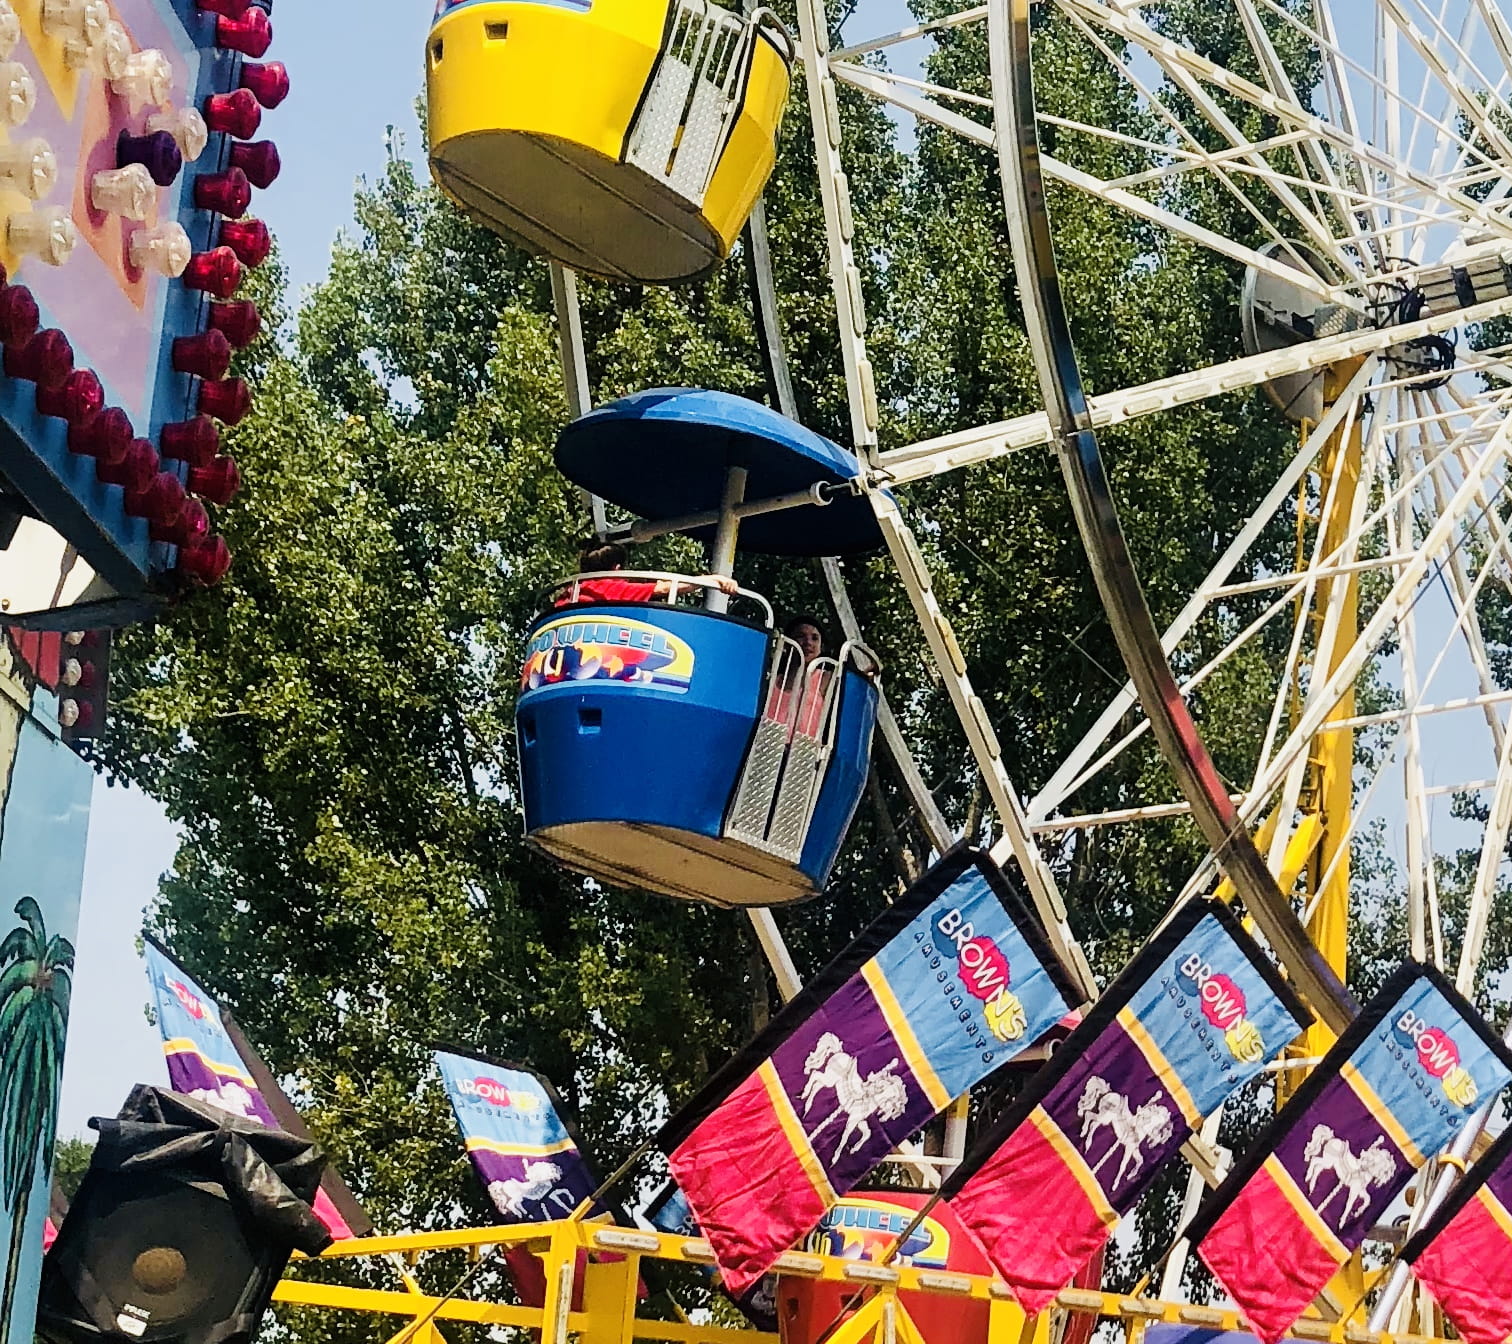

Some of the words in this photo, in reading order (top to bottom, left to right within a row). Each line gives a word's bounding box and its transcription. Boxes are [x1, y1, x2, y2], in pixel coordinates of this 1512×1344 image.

[557, 622, 674, 659] WHEEL
[914, 931, 994, 1063] AMUSEMENTS
[937, 908, 1028, 1041] BROWN'S
[1180, 952, 1266, 1063] BROWN'S
[1396, 1010, 1479, 1106] BROWN'S
